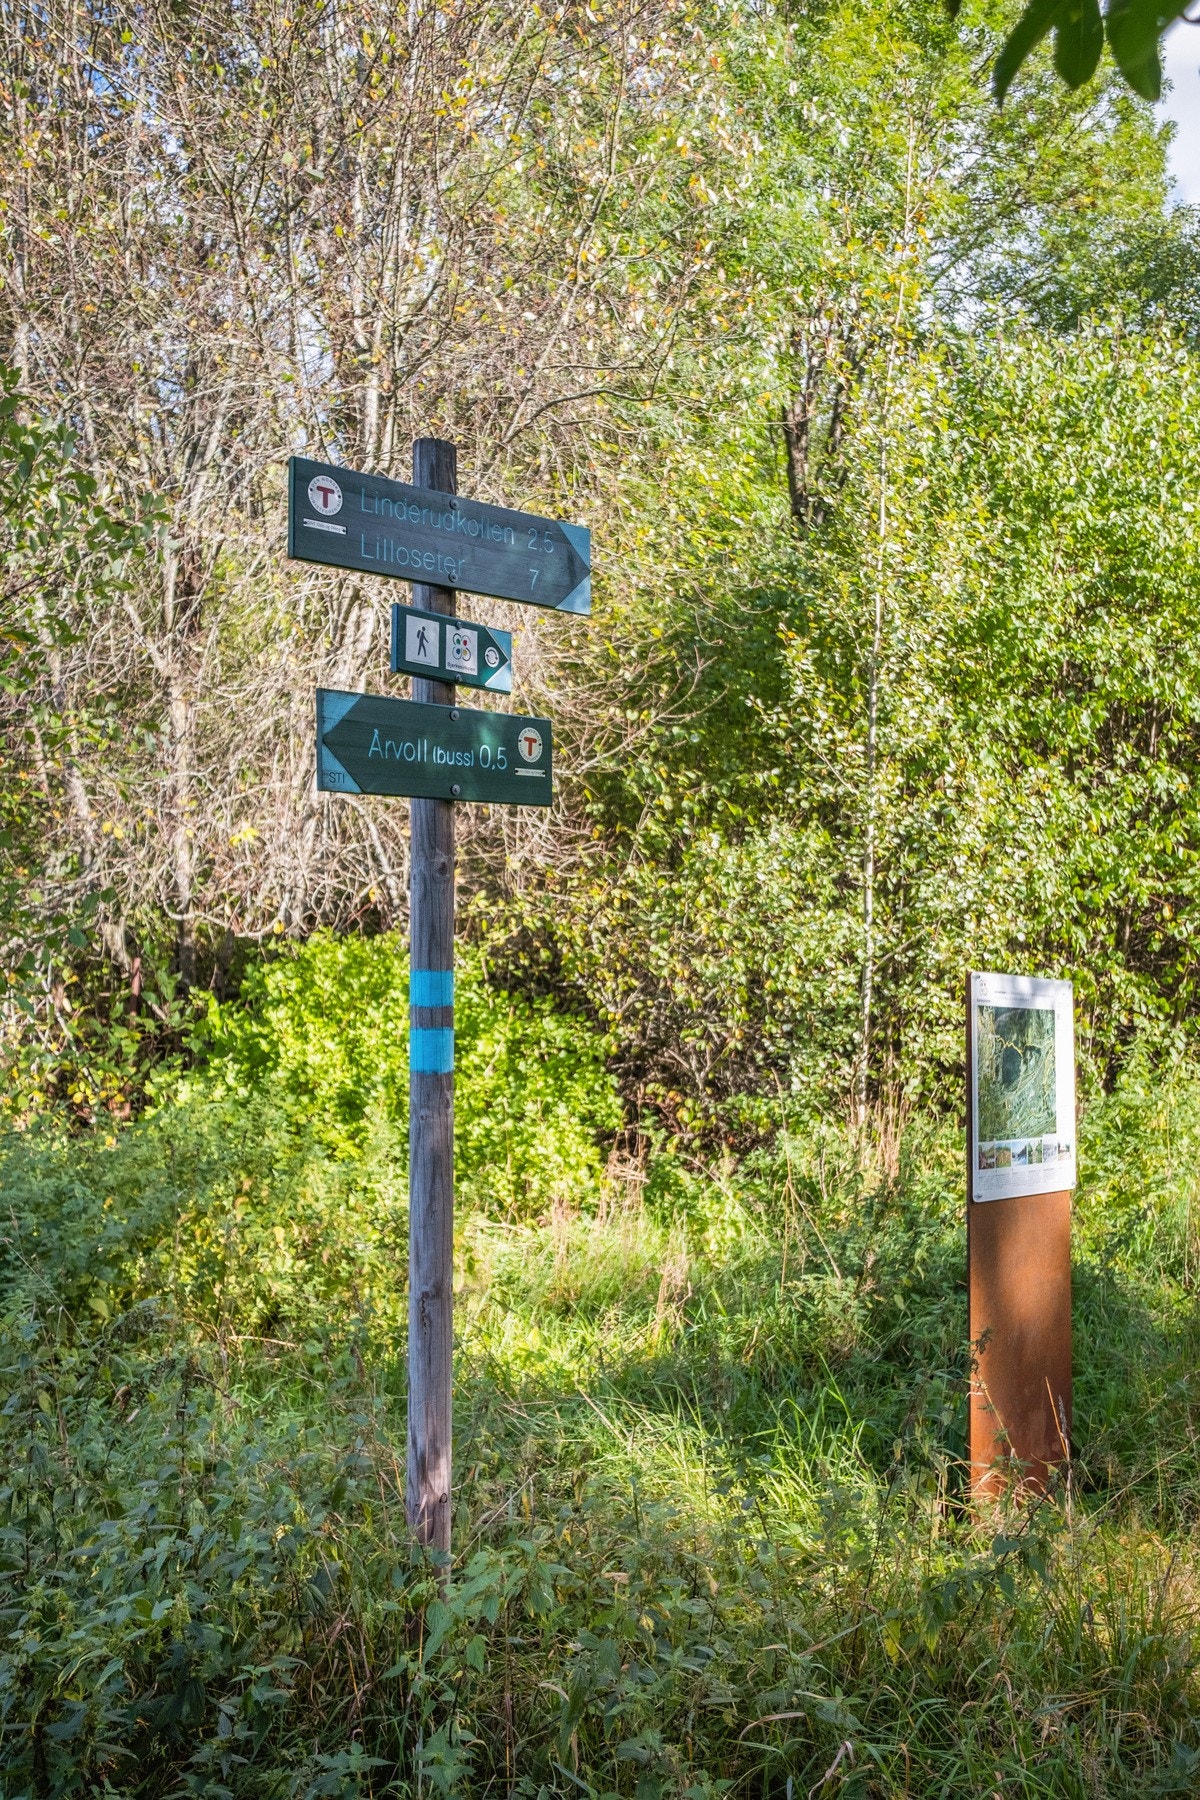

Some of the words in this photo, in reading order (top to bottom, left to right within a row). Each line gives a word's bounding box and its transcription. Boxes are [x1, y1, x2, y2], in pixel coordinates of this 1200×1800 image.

[316, 485, 335, 509] T
[361, 488, 515, 545] Linderudkollen
[361, 533, 466, 576] Lilloseter
[528, 569, 540, 590] 7
[368, 728, 428, 763] Årvoll
[432, 745, 474, 767] (buss)
[479, 744, 508, 770] 0,5
[523, 736, 537, 757] T
